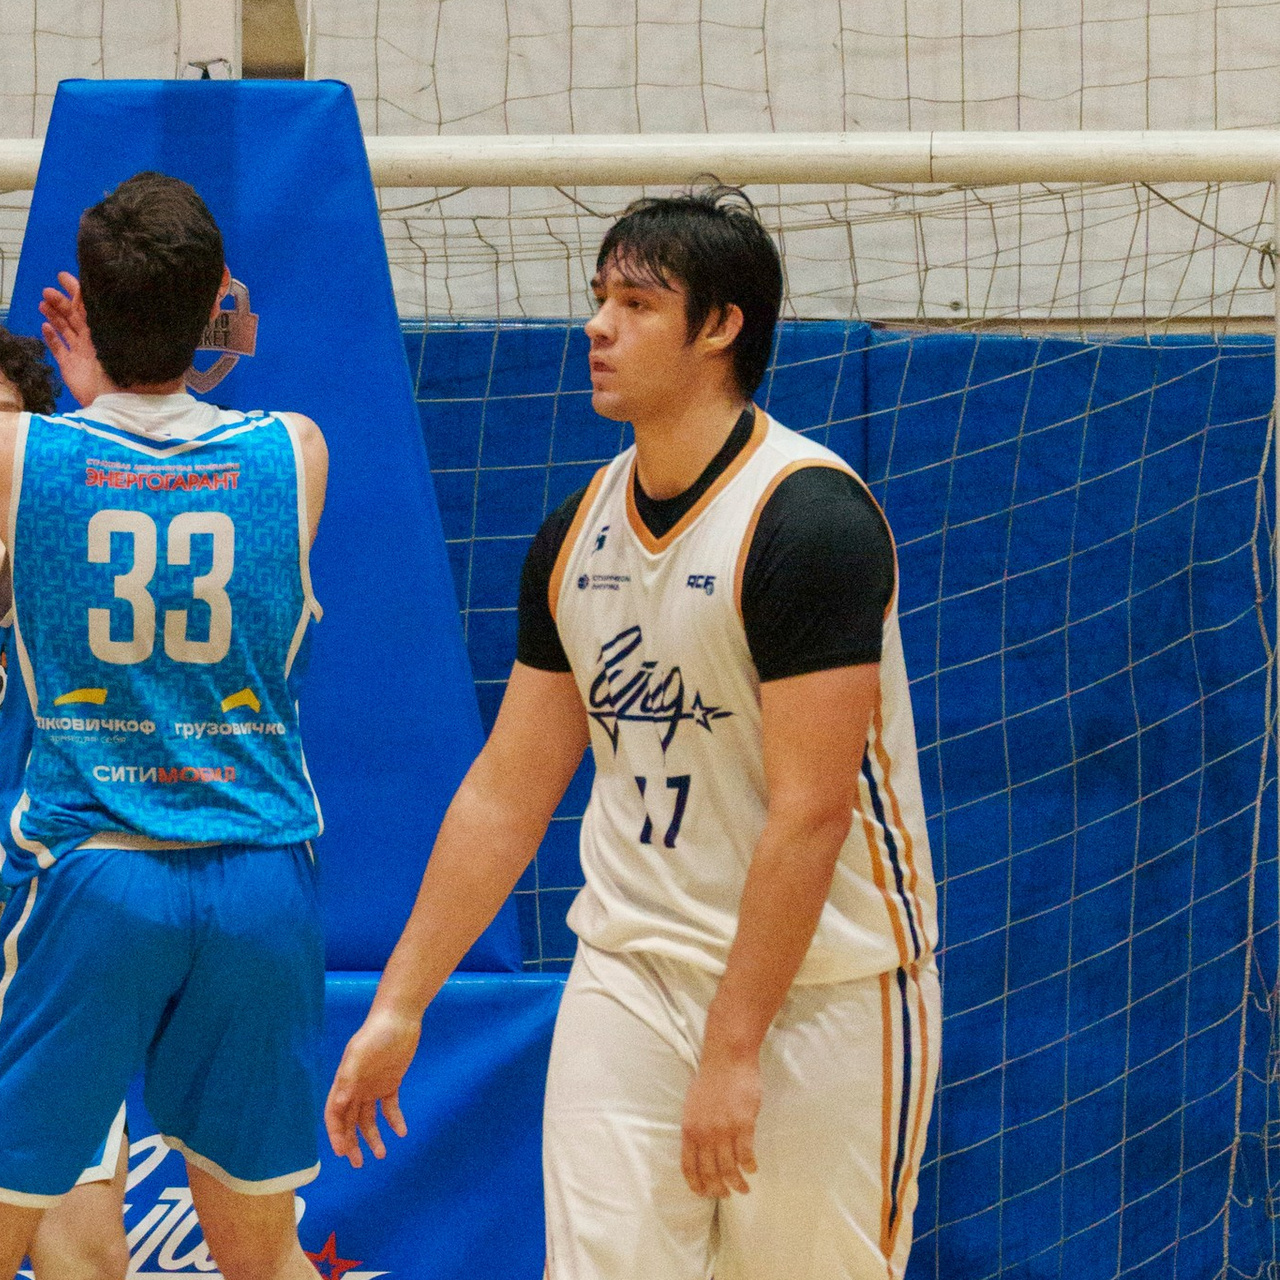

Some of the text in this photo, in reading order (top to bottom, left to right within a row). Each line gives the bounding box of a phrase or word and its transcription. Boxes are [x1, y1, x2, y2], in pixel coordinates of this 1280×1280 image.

[84, 467, 241, 492] ЭНЕРГОГАРАНТ
[87, 508, 236, 665] 33
[92, 765, 236, 784] СИТИМОБИЛ
[634, 774, 692, 849] 17
